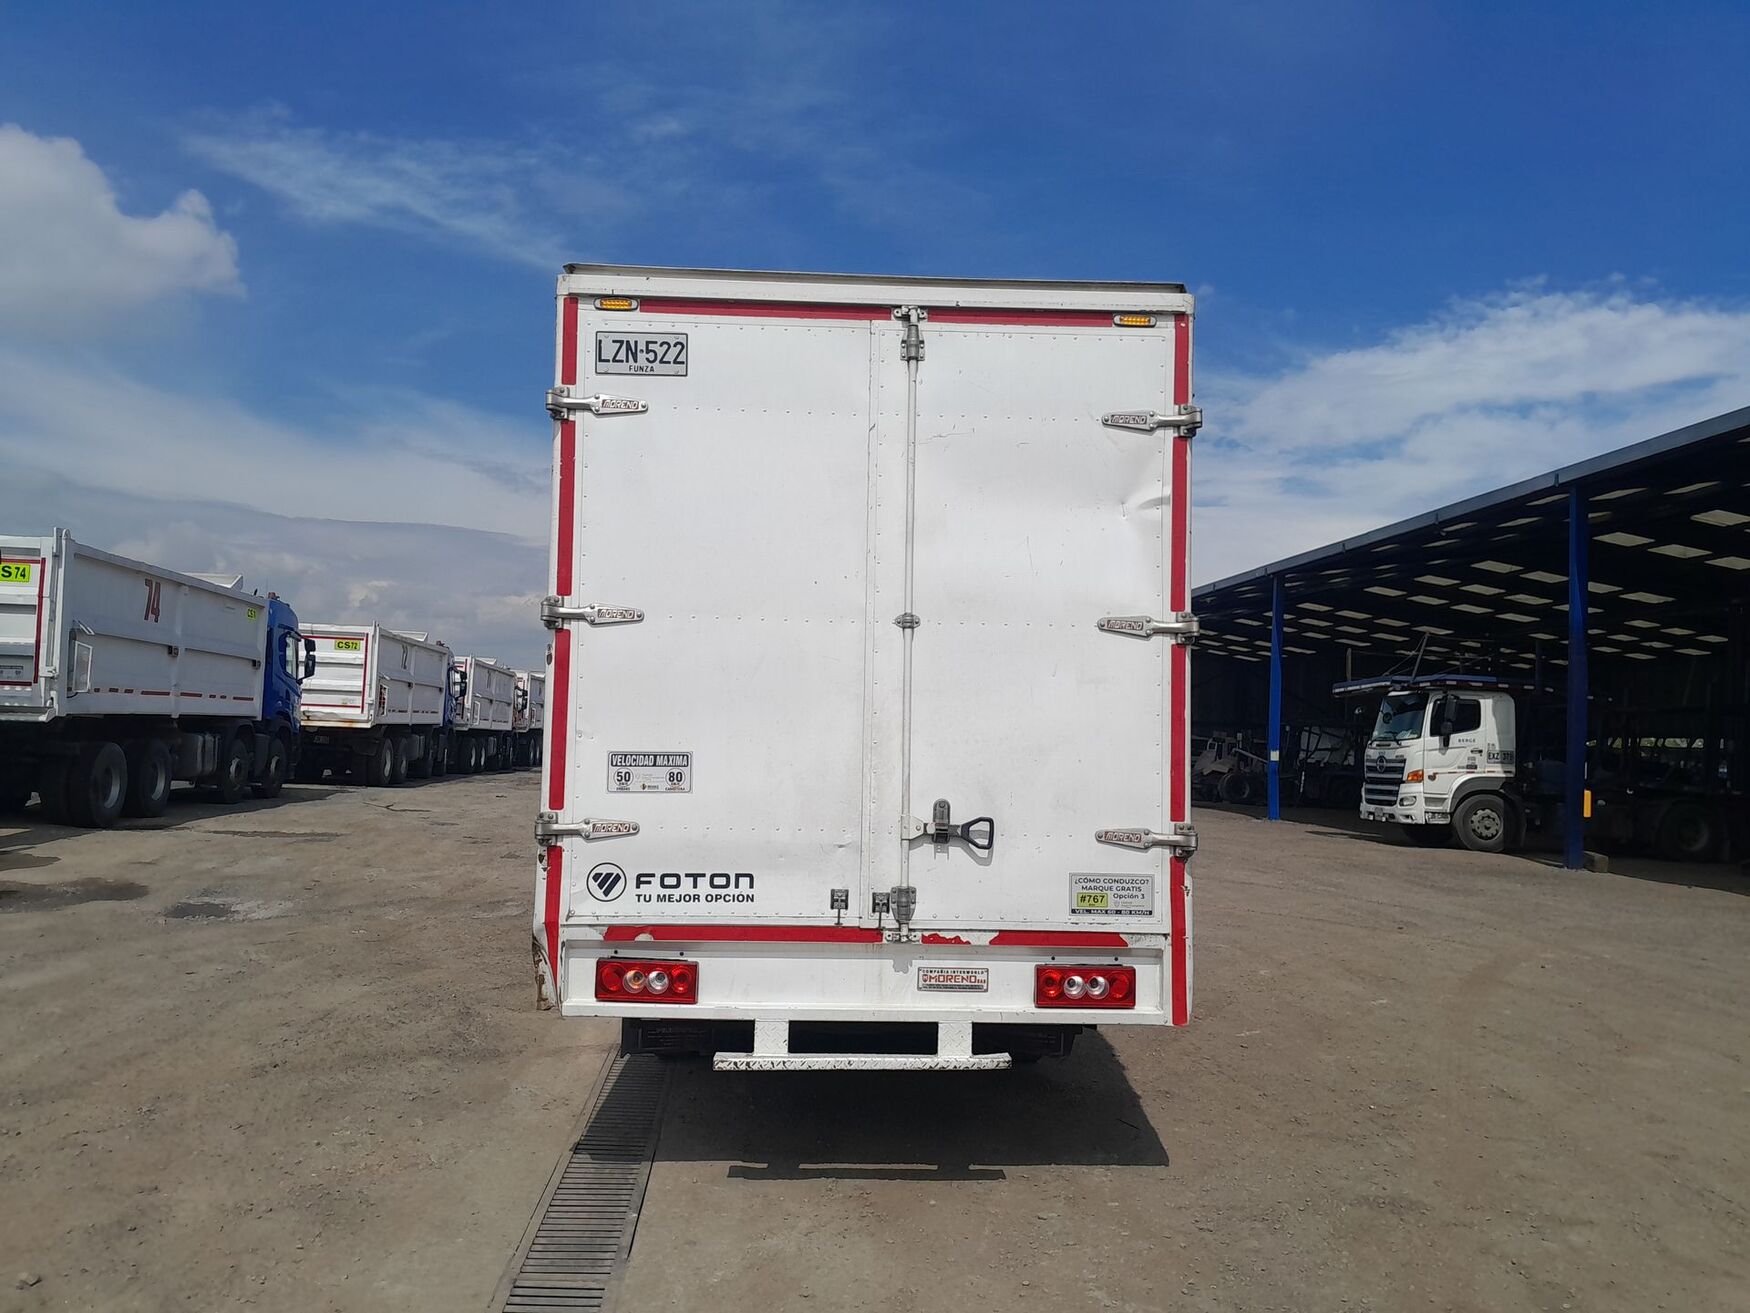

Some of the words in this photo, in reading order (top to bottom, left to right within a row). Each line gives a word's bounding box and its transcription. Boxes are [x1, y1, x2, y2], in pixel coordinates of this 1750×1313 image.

[629, 365, 655, 373] FUNZA
[602, 399, 639, 410] MORENO
[1111, 415, 1147, 424] MORENO
[599, 609, 635, 619] MORENO
[1107, 620, 1143, 630] MORENO
[612, 754, 654, 766] VELOCIDAD
[656, 755, 688, 766] MAXIMA
[616, 771, 631, 782] 50
[668, 771, 683, 782] 80
[593, 823, 630, 833] MORENO
[1105, 831, 1142, 843] MORENO
[635, 873, 755, 889] FOTON
[635, 894, 652, 902] TU
[657, 894, 700, 903] MEJOR
[705, 891, 755, 903] OPCIÓN
[1080, 895, 1105, 903] #767
[929, 974, 977, 983] MORENO
